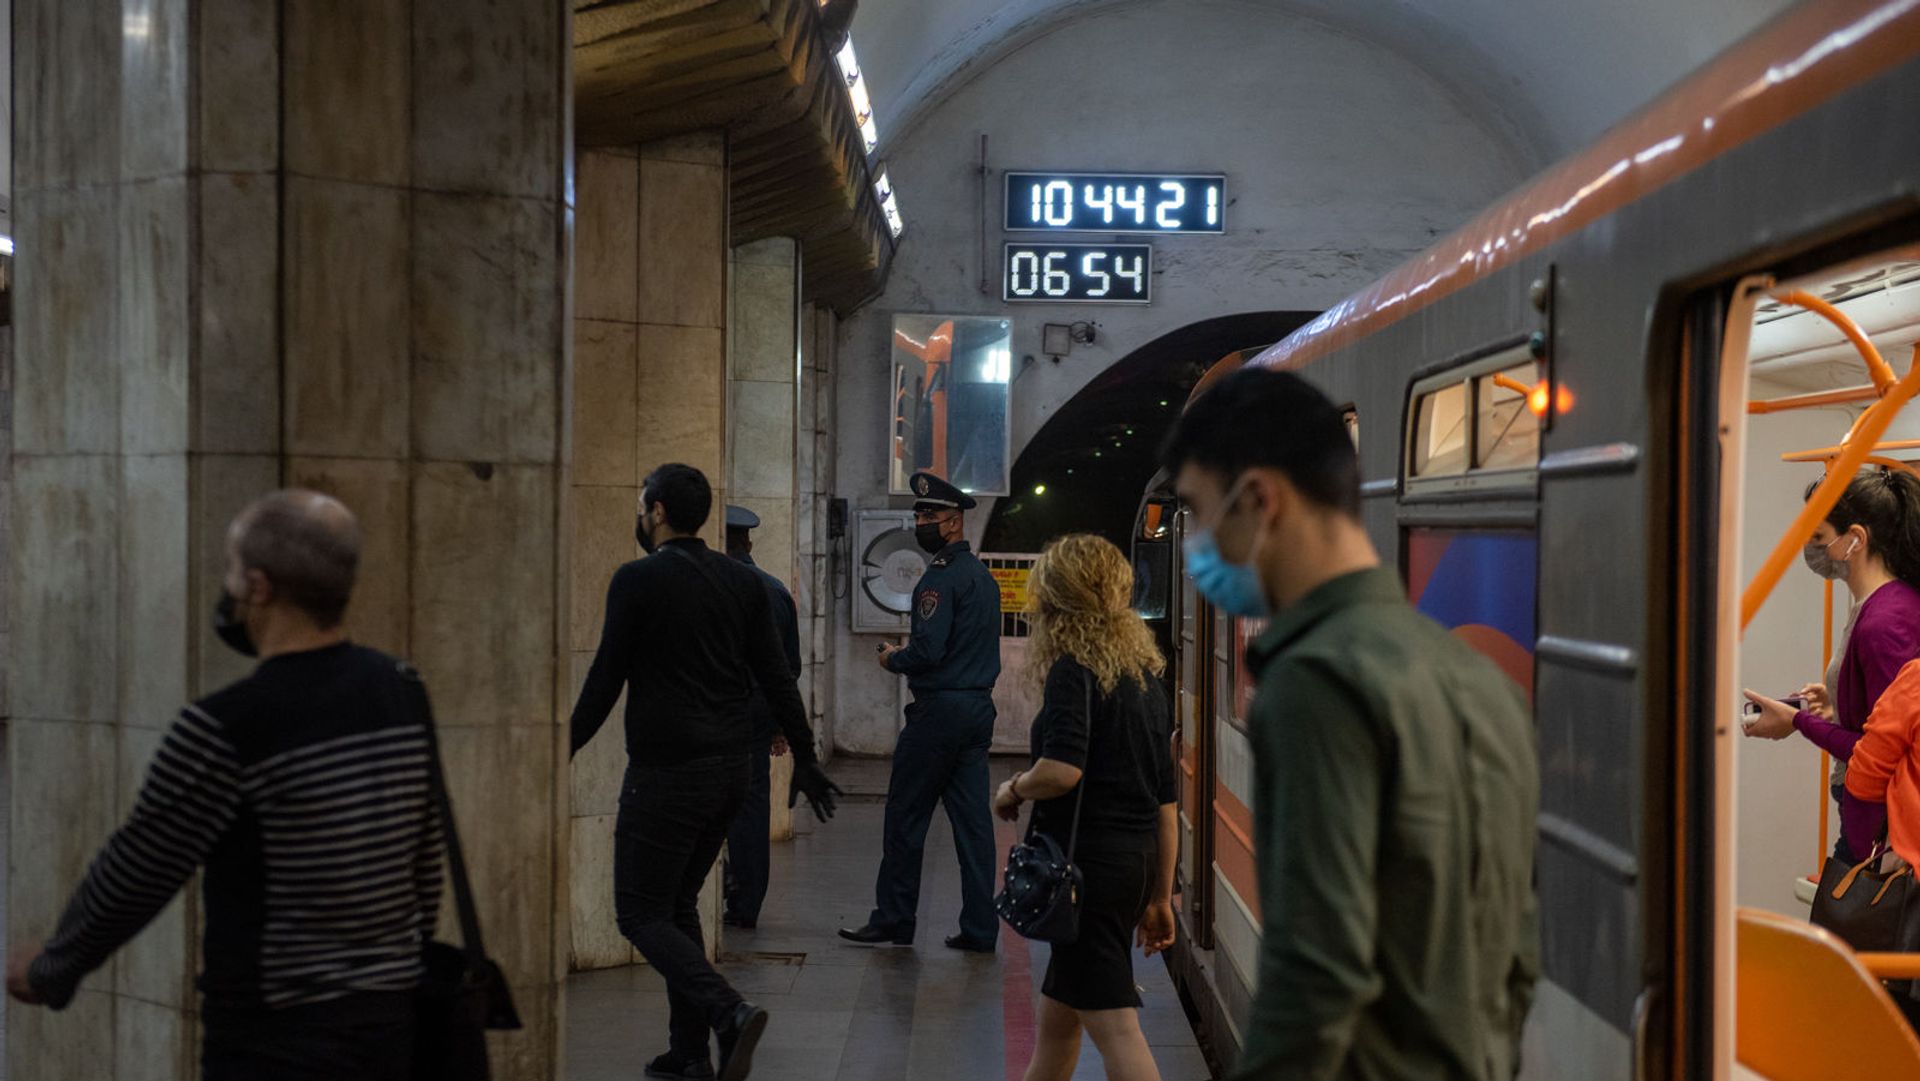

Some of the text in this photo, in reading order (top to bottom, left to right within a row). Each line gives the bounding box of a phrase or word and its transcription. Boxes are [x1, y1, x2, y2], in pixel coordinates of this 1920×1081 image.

[1031, 181, 1073, 226] 10
[1084, 184, 1145, 224] 44
[1011, 251, 1143, 296] 06 54
